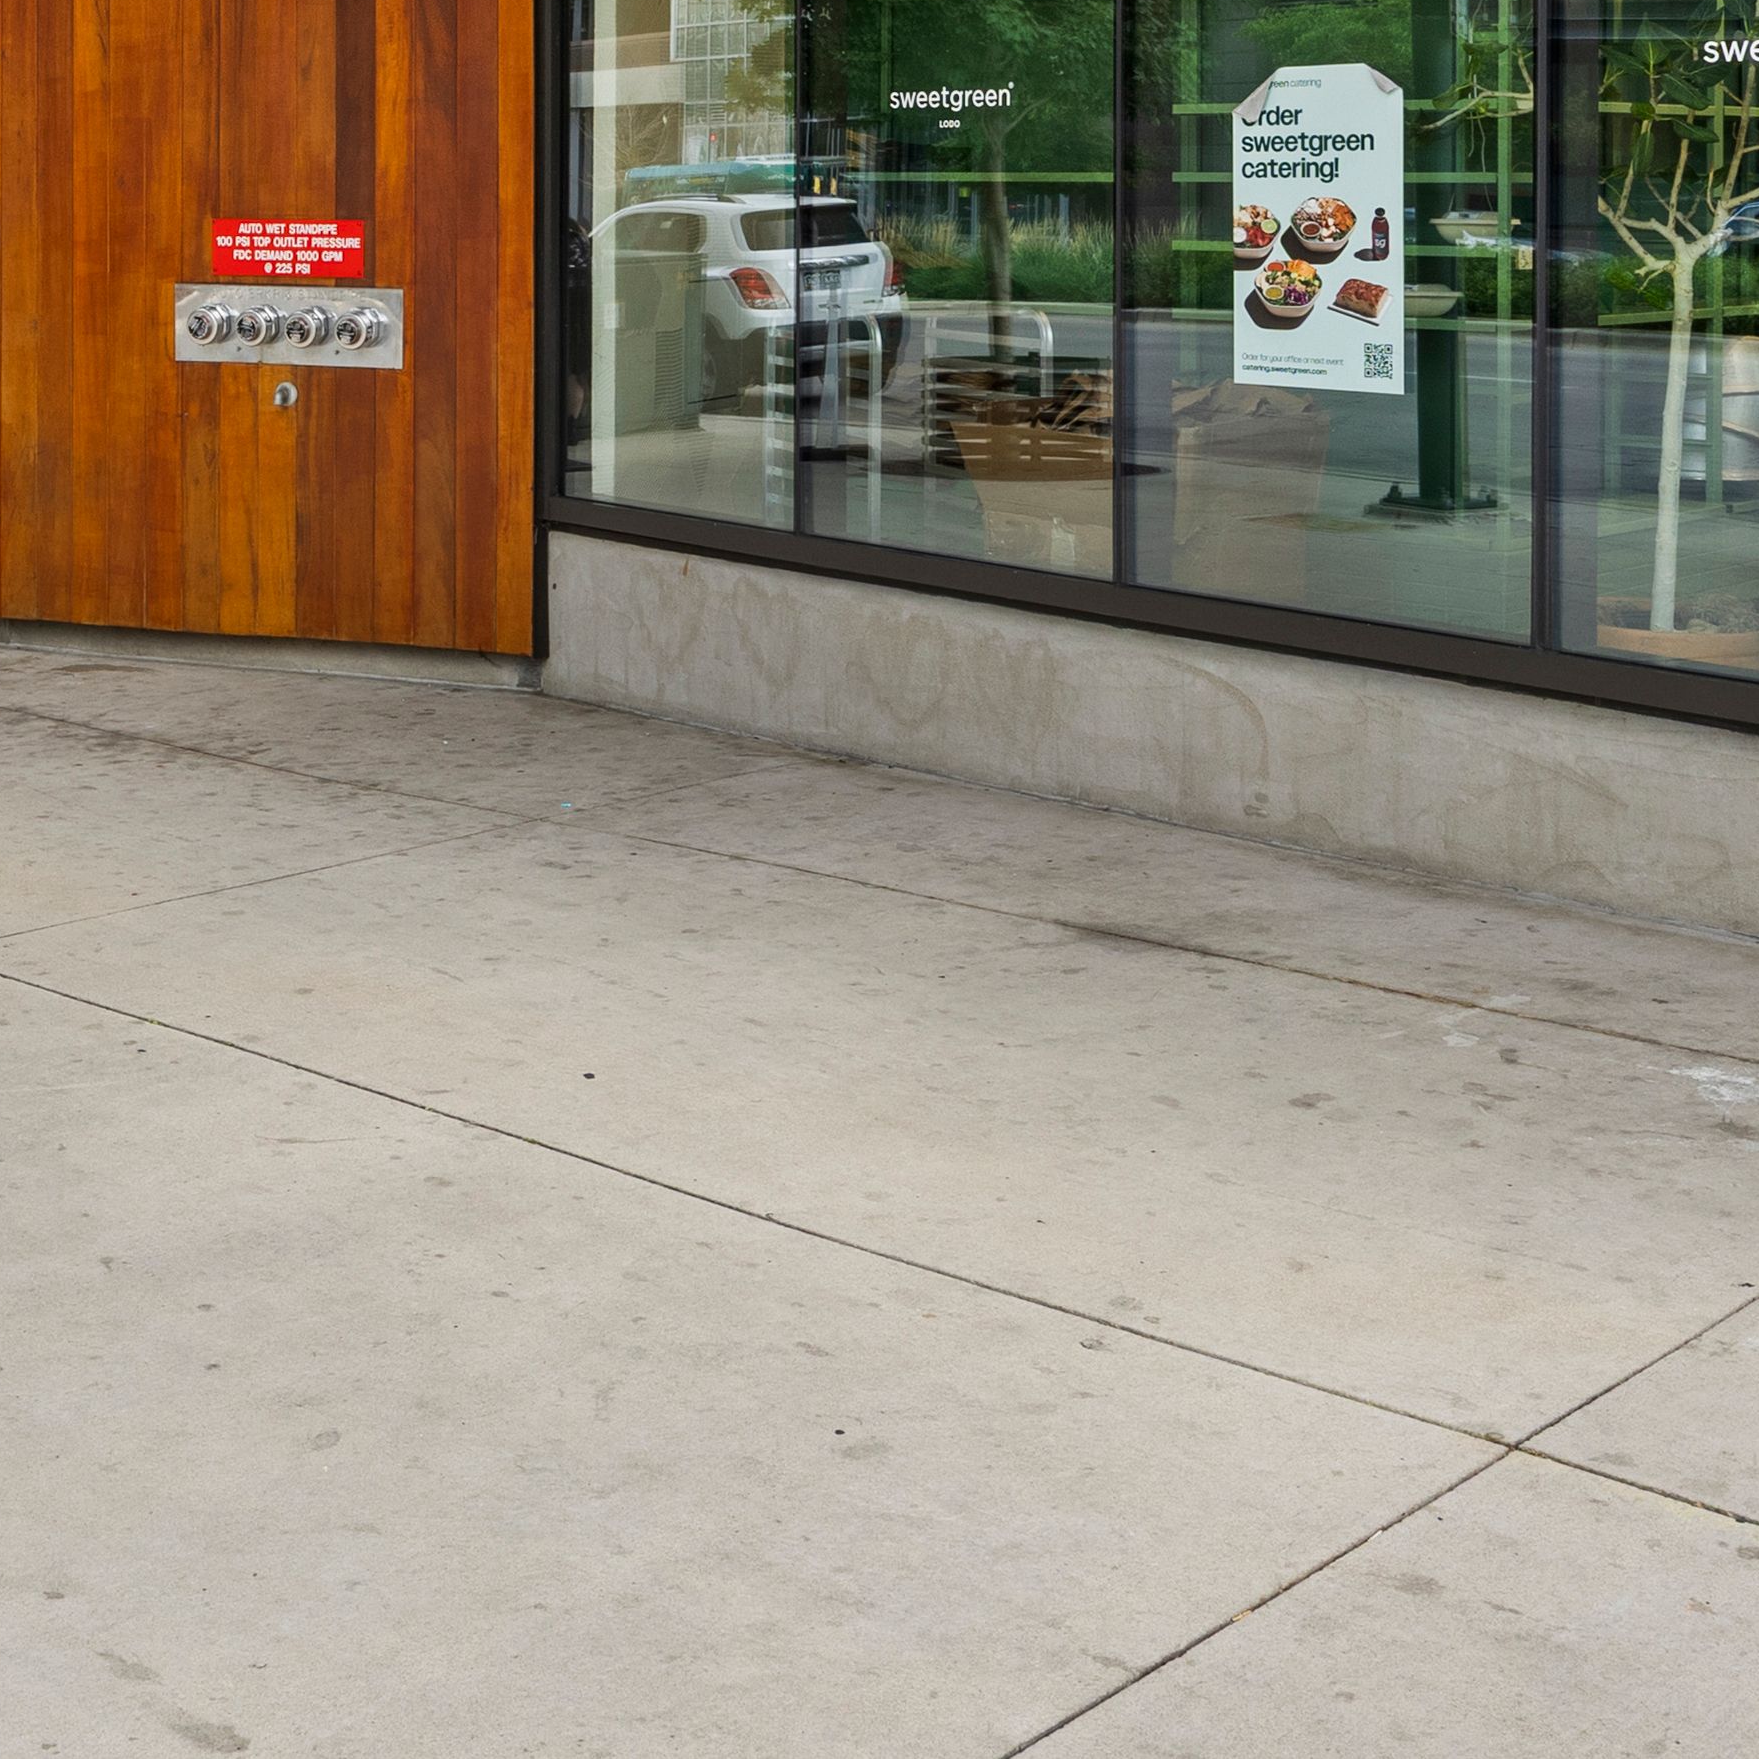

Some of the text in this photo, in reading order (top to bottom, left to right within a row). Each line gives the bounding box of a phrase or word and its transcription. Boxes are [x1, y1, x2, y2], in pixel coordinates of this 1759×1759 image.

[1290, 79, 1322, 89] catering
[1241, 132, 1375, 157] sweetgreen
[1242, 157, 1340, 184] catering!
[238, 223, 338, 235] AUTO WET STANDPIPE
[216, 236, 361, 249] 100 PSI TOP OUTLET PRESSURE
[233, 249, 343, 262] FDC DEMAND 1000 GPM
[275, 263, 293, 274] 225
[295, 264, 311, 274] PSI
[1270, 354, 1283, 364] your
[1242, 363, 1328, 376] catering.sweetgreen.com
